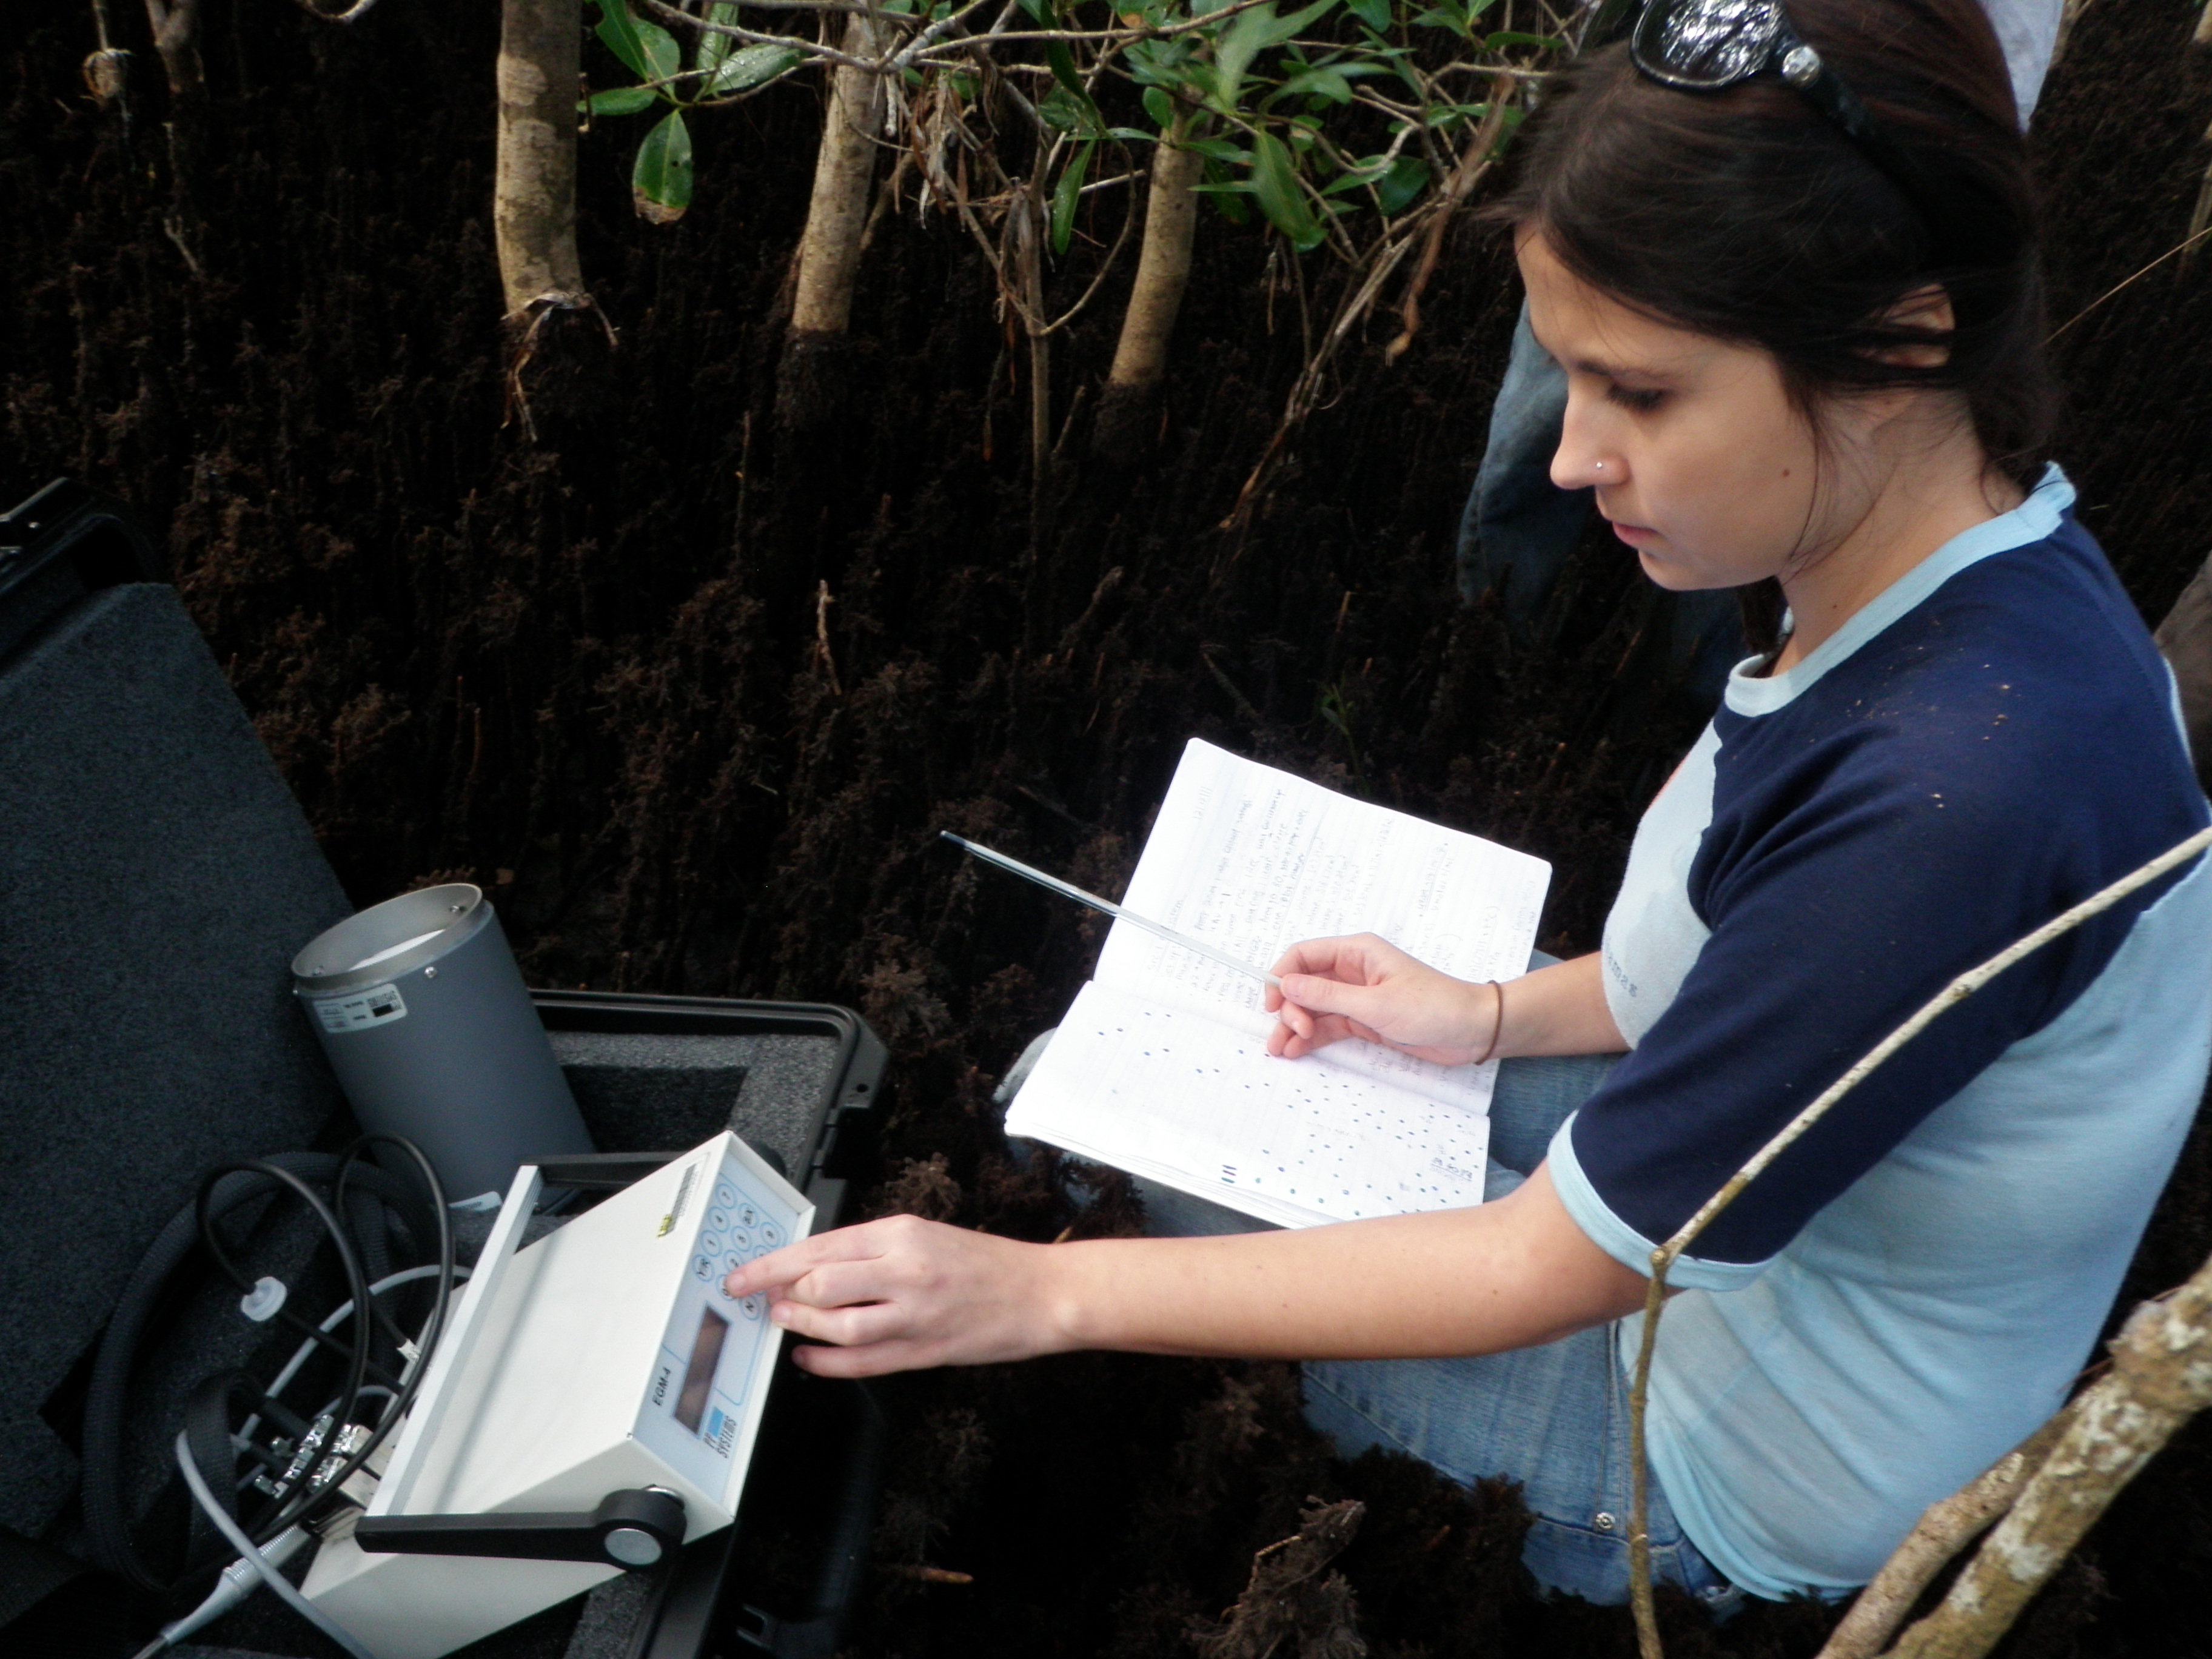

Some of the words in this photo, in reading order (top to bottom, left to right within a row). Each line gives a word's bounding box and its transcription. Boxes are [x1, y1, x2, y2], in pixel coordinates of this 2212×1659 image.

[697, 1258, 711, 1276] Y/R
[745, 1301, 755, 1312] N
[652, 1367, 671, 1406] EGM-4
[703, 1432, 716, 1449] PP
[716, 1416, 738, 1458] SYSTEMS
